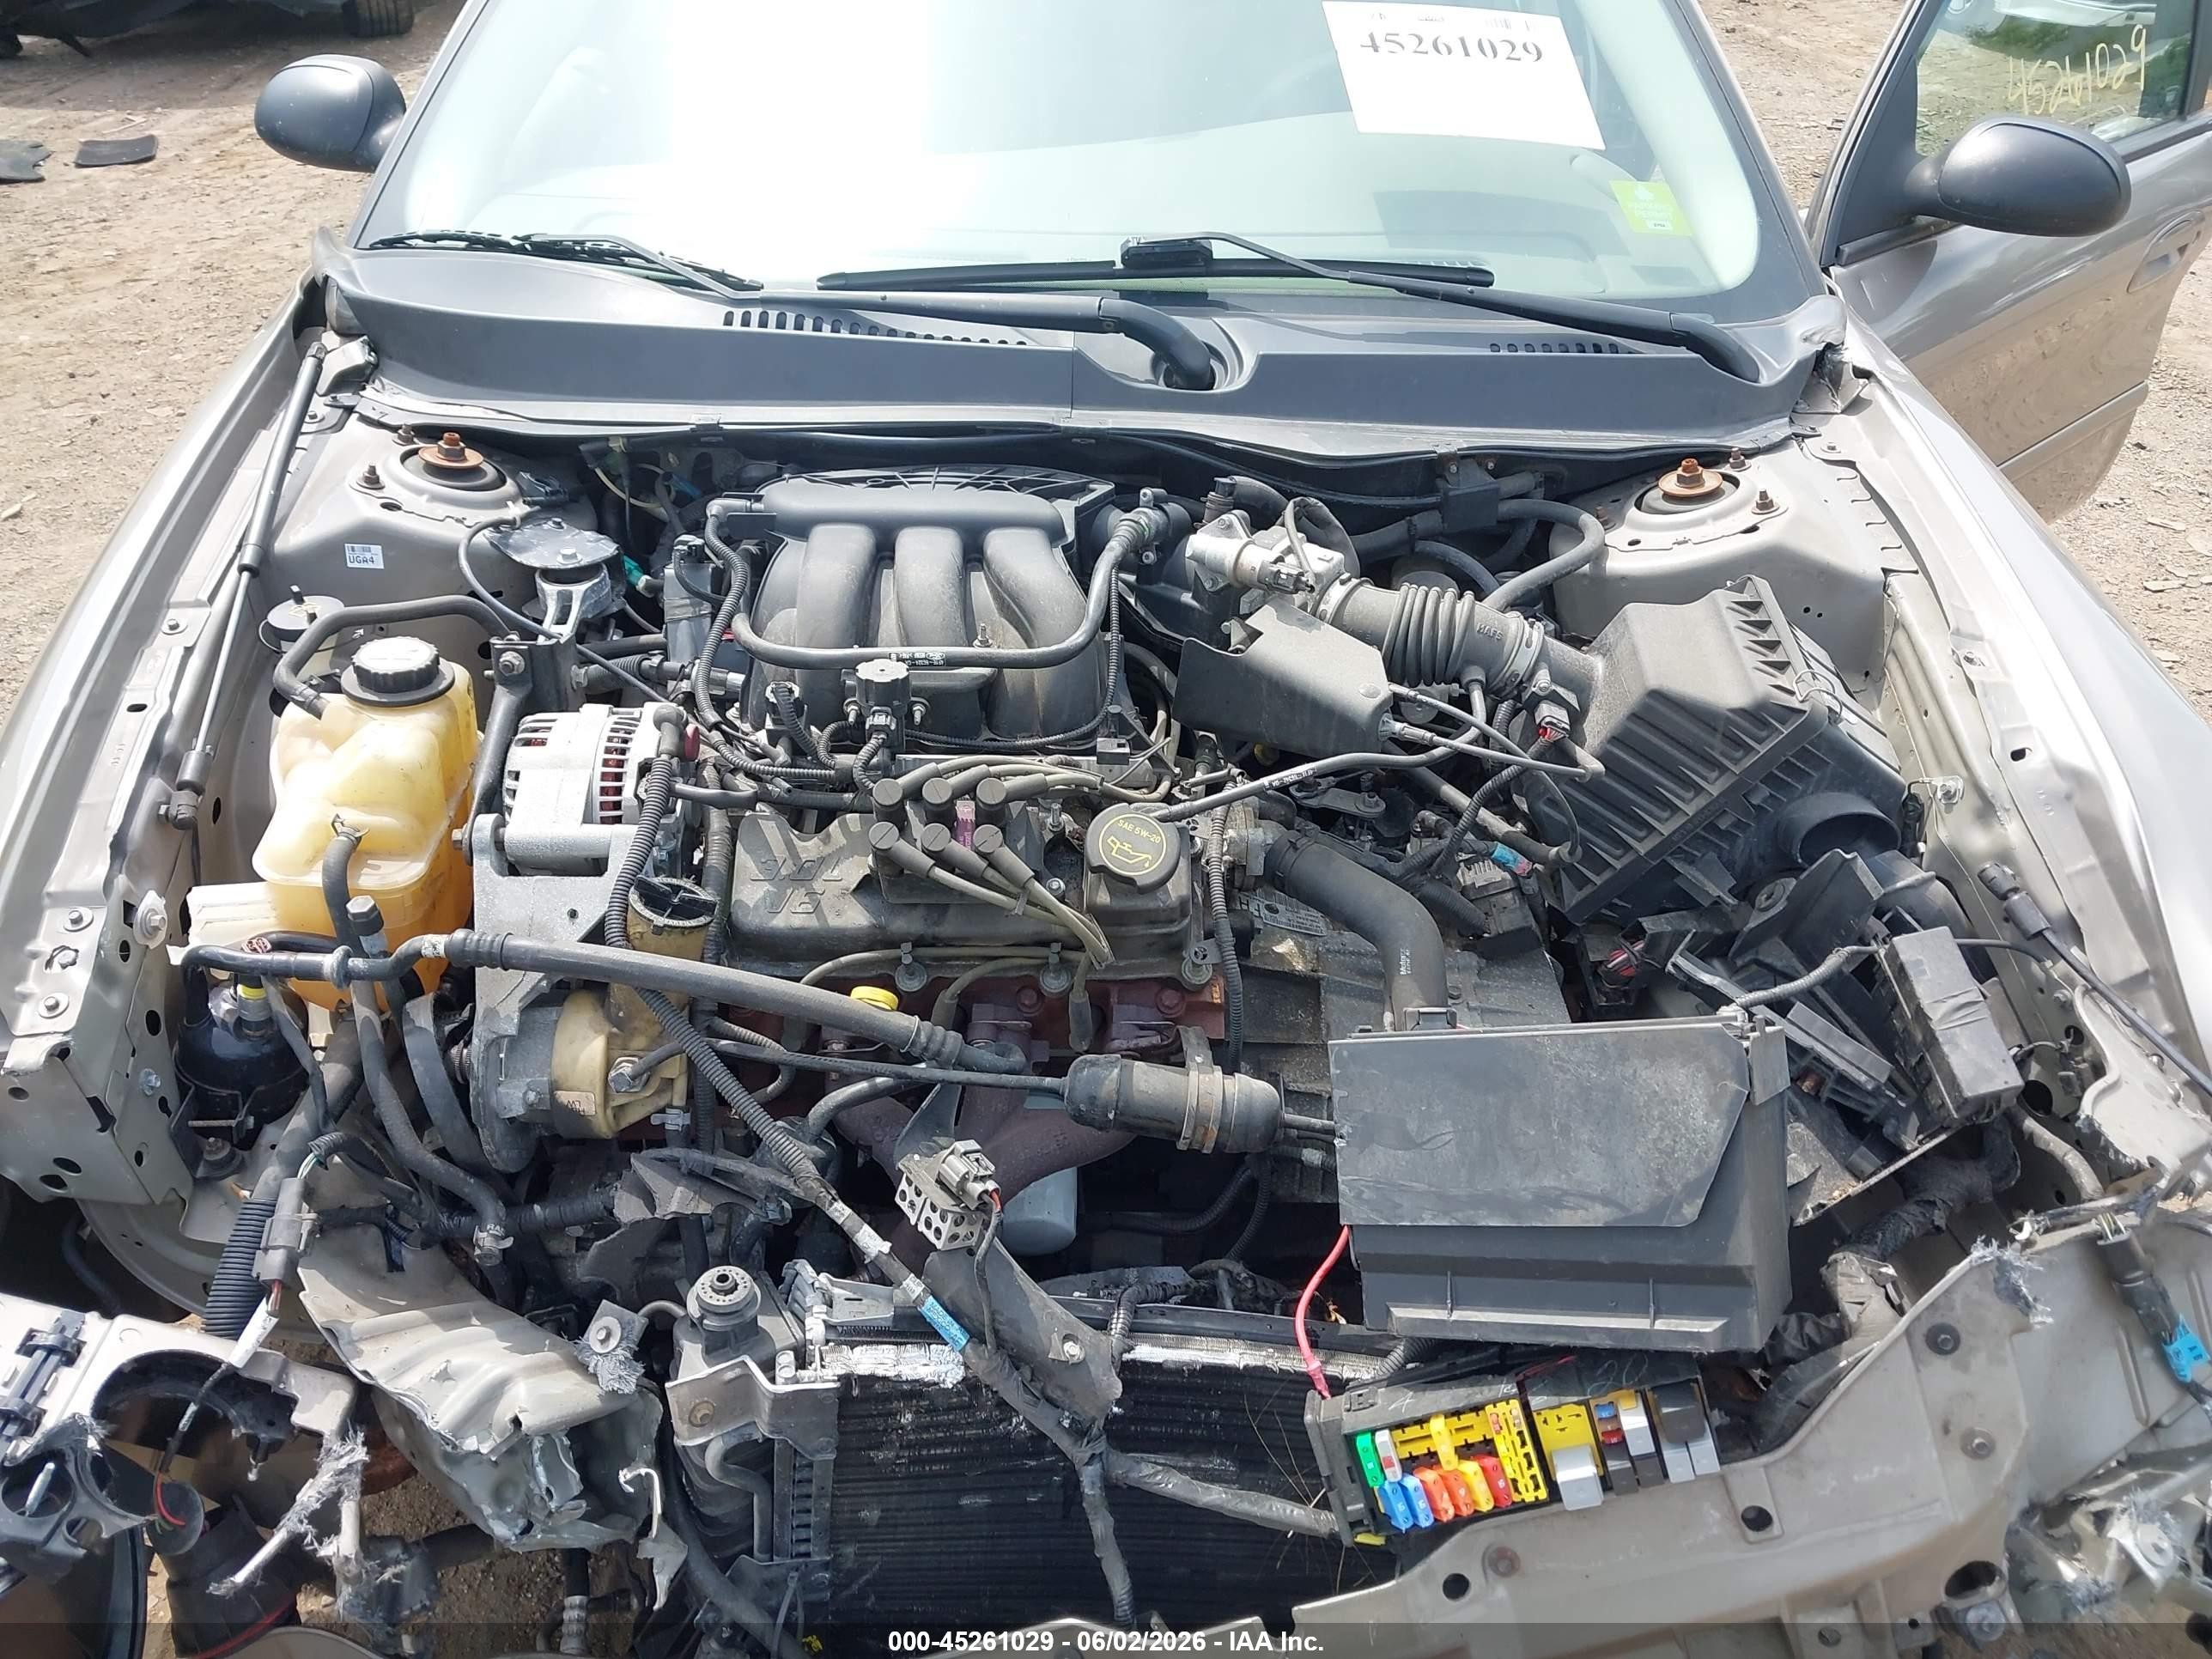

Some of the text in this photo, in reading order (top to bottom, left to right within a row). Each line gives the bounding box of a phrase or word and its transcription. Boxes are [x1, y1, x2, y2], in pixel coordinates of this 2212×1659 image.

[1360, 31, 1542, 62] 45261029
[2007, 24, 2147, 115] 45261029
[349, 555, 375, 564] UGA4
[1117, 819, 1162, 844] SAE 5W-20
